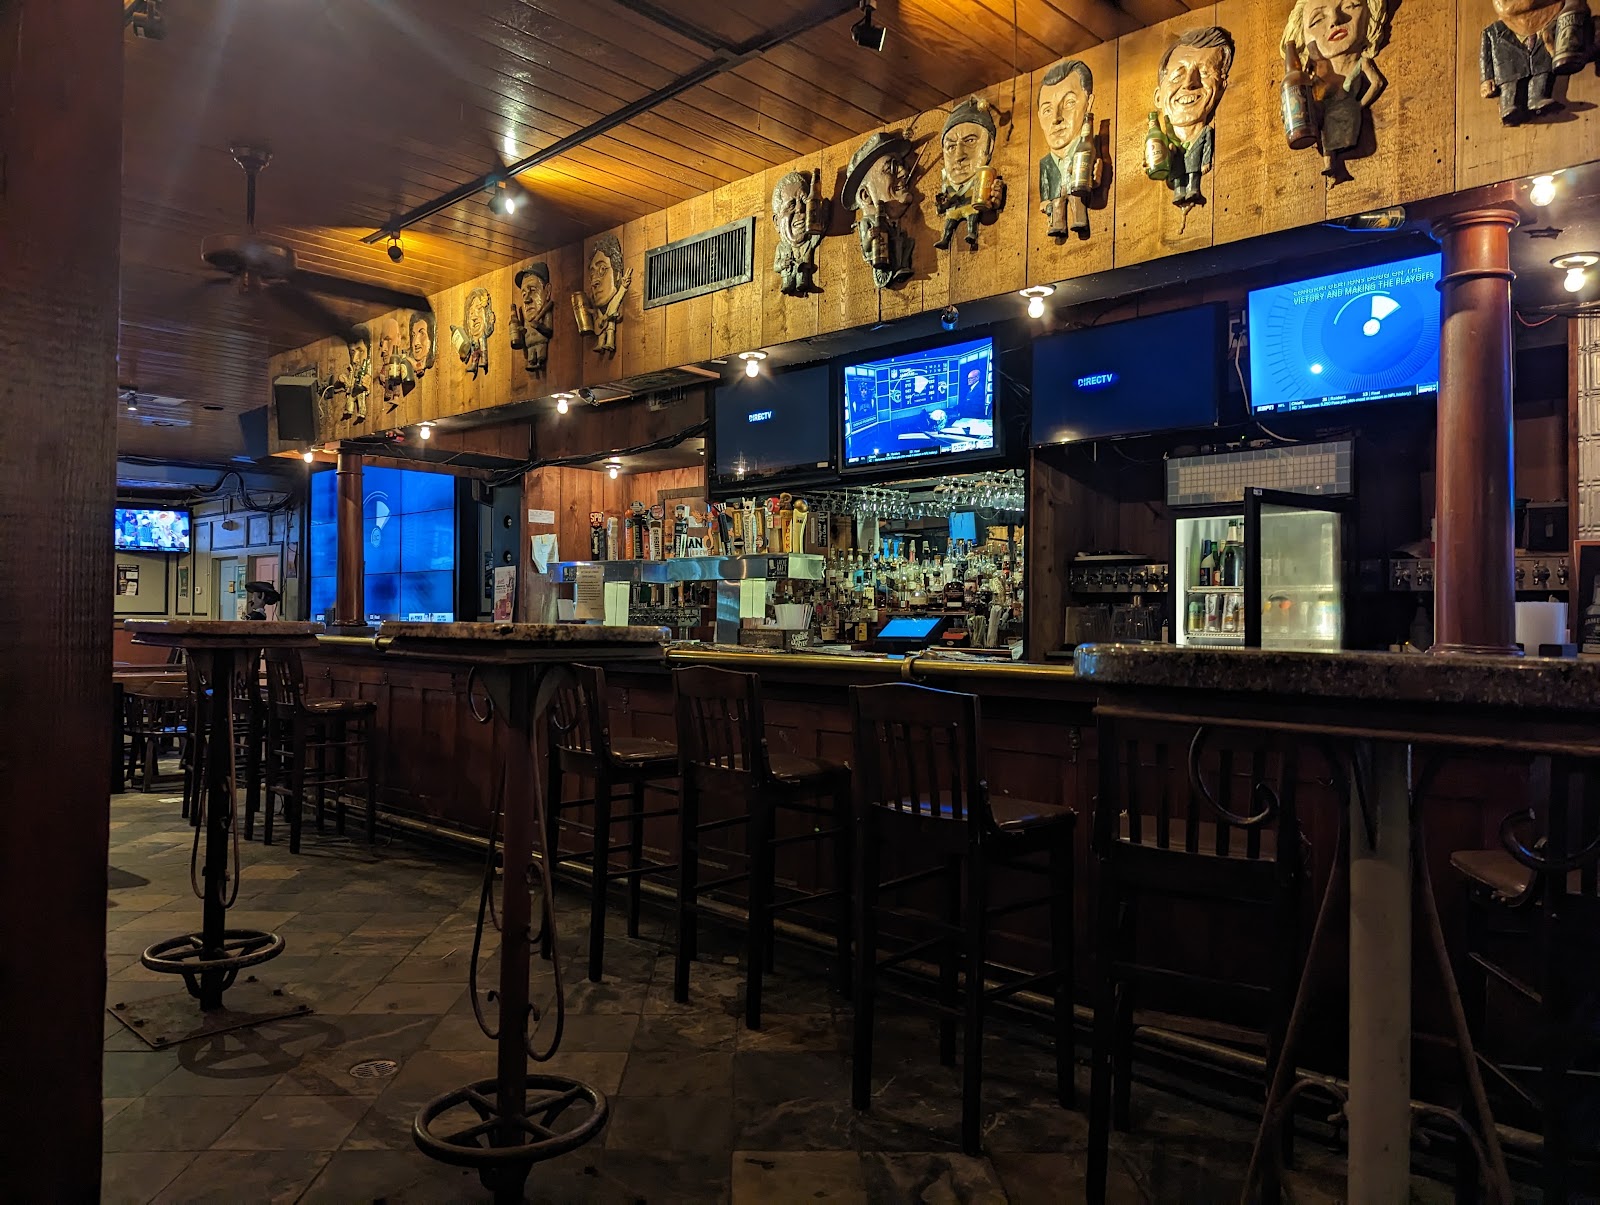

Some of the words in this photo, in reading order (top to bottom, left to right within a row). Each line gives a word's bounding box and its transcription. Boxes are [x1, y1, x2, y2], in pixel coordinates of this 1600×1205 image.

[1326, 289, 1343, 299] AND
[1345, 283, 1376, 296] MAKING
[1379, 278, 1394, 289] THE
[1395, 270, 1435, 287] PLAYOFFS
[1077, 373, 1113, 387] DIRECTV
[748, 411, 772, 422] DIRECTV
